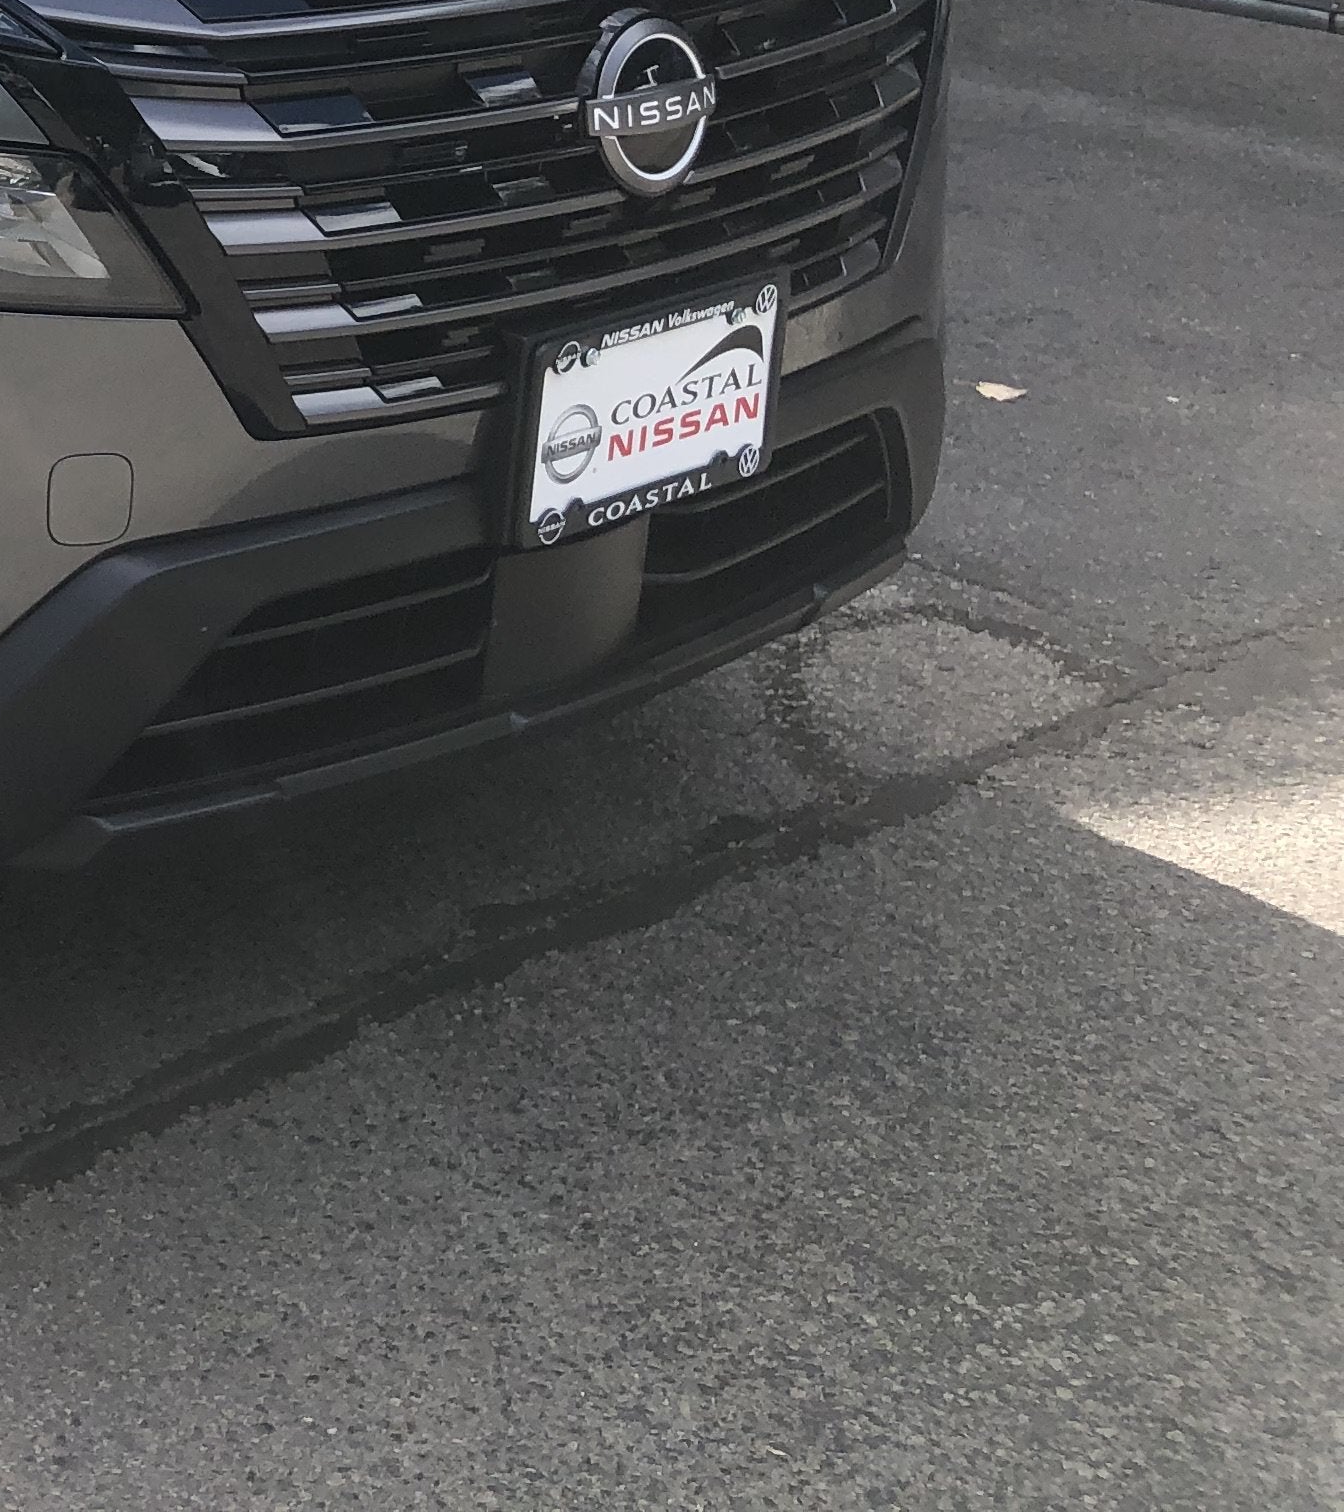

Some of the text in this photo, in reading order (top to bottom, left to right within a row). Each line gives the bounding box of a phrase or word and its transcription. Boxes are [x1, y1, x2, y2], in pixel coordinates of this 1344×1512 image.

[594, 82, 716, 131] NISSAN
[601, 300, 735, 348] NISSAN Volkswagen
[610, 363, 763, 426] COASTAL
[546, 431, 597, 457] NISSAN
[607, 392, 760, 462] NISSAN
[587, 472, 713, 528] COASTAL
